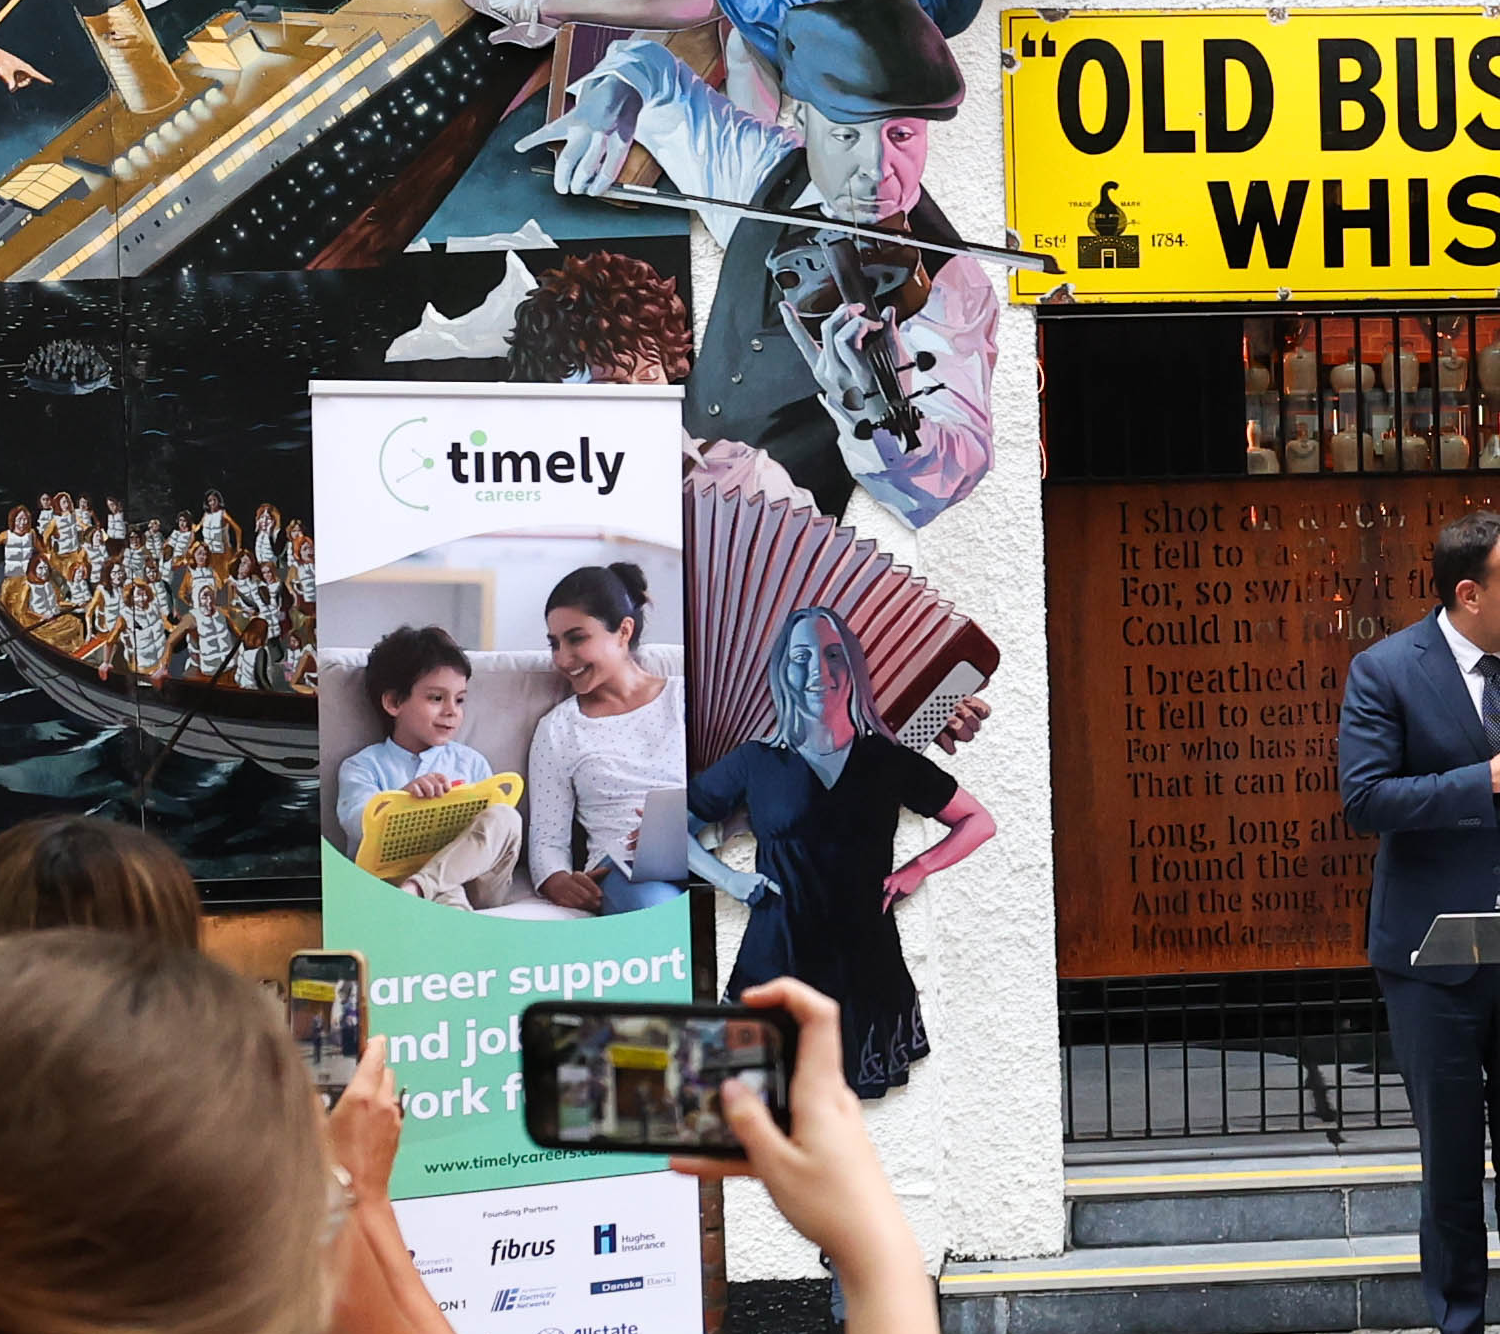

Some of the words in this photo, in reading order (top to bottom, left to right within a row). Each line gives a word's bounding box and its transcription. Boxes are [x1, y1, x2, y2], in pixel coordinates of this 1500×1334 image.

[1120, 200, 1140, 208] MARK
[447, 430, 625, 495] timely
[475, 489, 542, 502] careers
[1117, 501, 1129, 534] I
[1143, 499, 1225, 533] shot
[1239, 506, 1282, 531] an
[1118, 541, 1141, 569] It
[1153, 539, 1201, 568] fell
[1214, 542, 1244, 567] to
[1121, 574, 1183, 611] For,
[1195, 579, 1232, 605] so
[1244, 571, 1363, 605] swiftly
[1373, 571, 1394, 600] it
[1121, 614, 1220, 646] Could
[1124, 665, 1135, 697] I
[1147, 660, 1306, 696] breathed
[1320, 668, 1338, 691] a
[1125, 703, 1145, 731] It
[1158, 701, 1204, 730] fell
[1218, 704, 1248, 728] to
[1126, 739, 1170, 764] For
[1182, 731, 1238, 761] who
[1250, 731, 1296, 758] has
[1128, 770, 1193, 799] That
[1205, 766, 1225, 796] it
[1235, 768, 1285, 795] can
[1295, 763, 1339, 793] foll
[1128, 819, 1216, 853] Long,
[1228, 815, 1301, 849] long
[1129, 852, 1137, 884] I
[1150, 850, 1245, 883] found
[1256, 849, 1308, 879] the
[1133, 887, 1192, 917] And
[1198, 884, 1244, 914] the
[1252, 887, 1326, 917] song,
[1148, 920, 1243, 950] found
[369, 969, 498, 1005] areer
[509, 947, 686, 999] support
[388, 1021, 449, 1064] nd
[401, 1077, 490, 1120] ork
[483, 1208, 521, 1219] Founding
[523, 1204, 558, 1215] Partners
[491, 1238, 556, 1266] fibrus
[621, 1232, 656, 1245] Hughes
[621, 1241, 666, 1252] Insurance
[417, 1267, 453, 1276] usiness
[602, 1279, 642, 1292] Danske
[647, 1276, 673, 1286] Bank
[517, 1300, 551, 1310] Networks
[519, 1290, 557, 1302] Electricity
